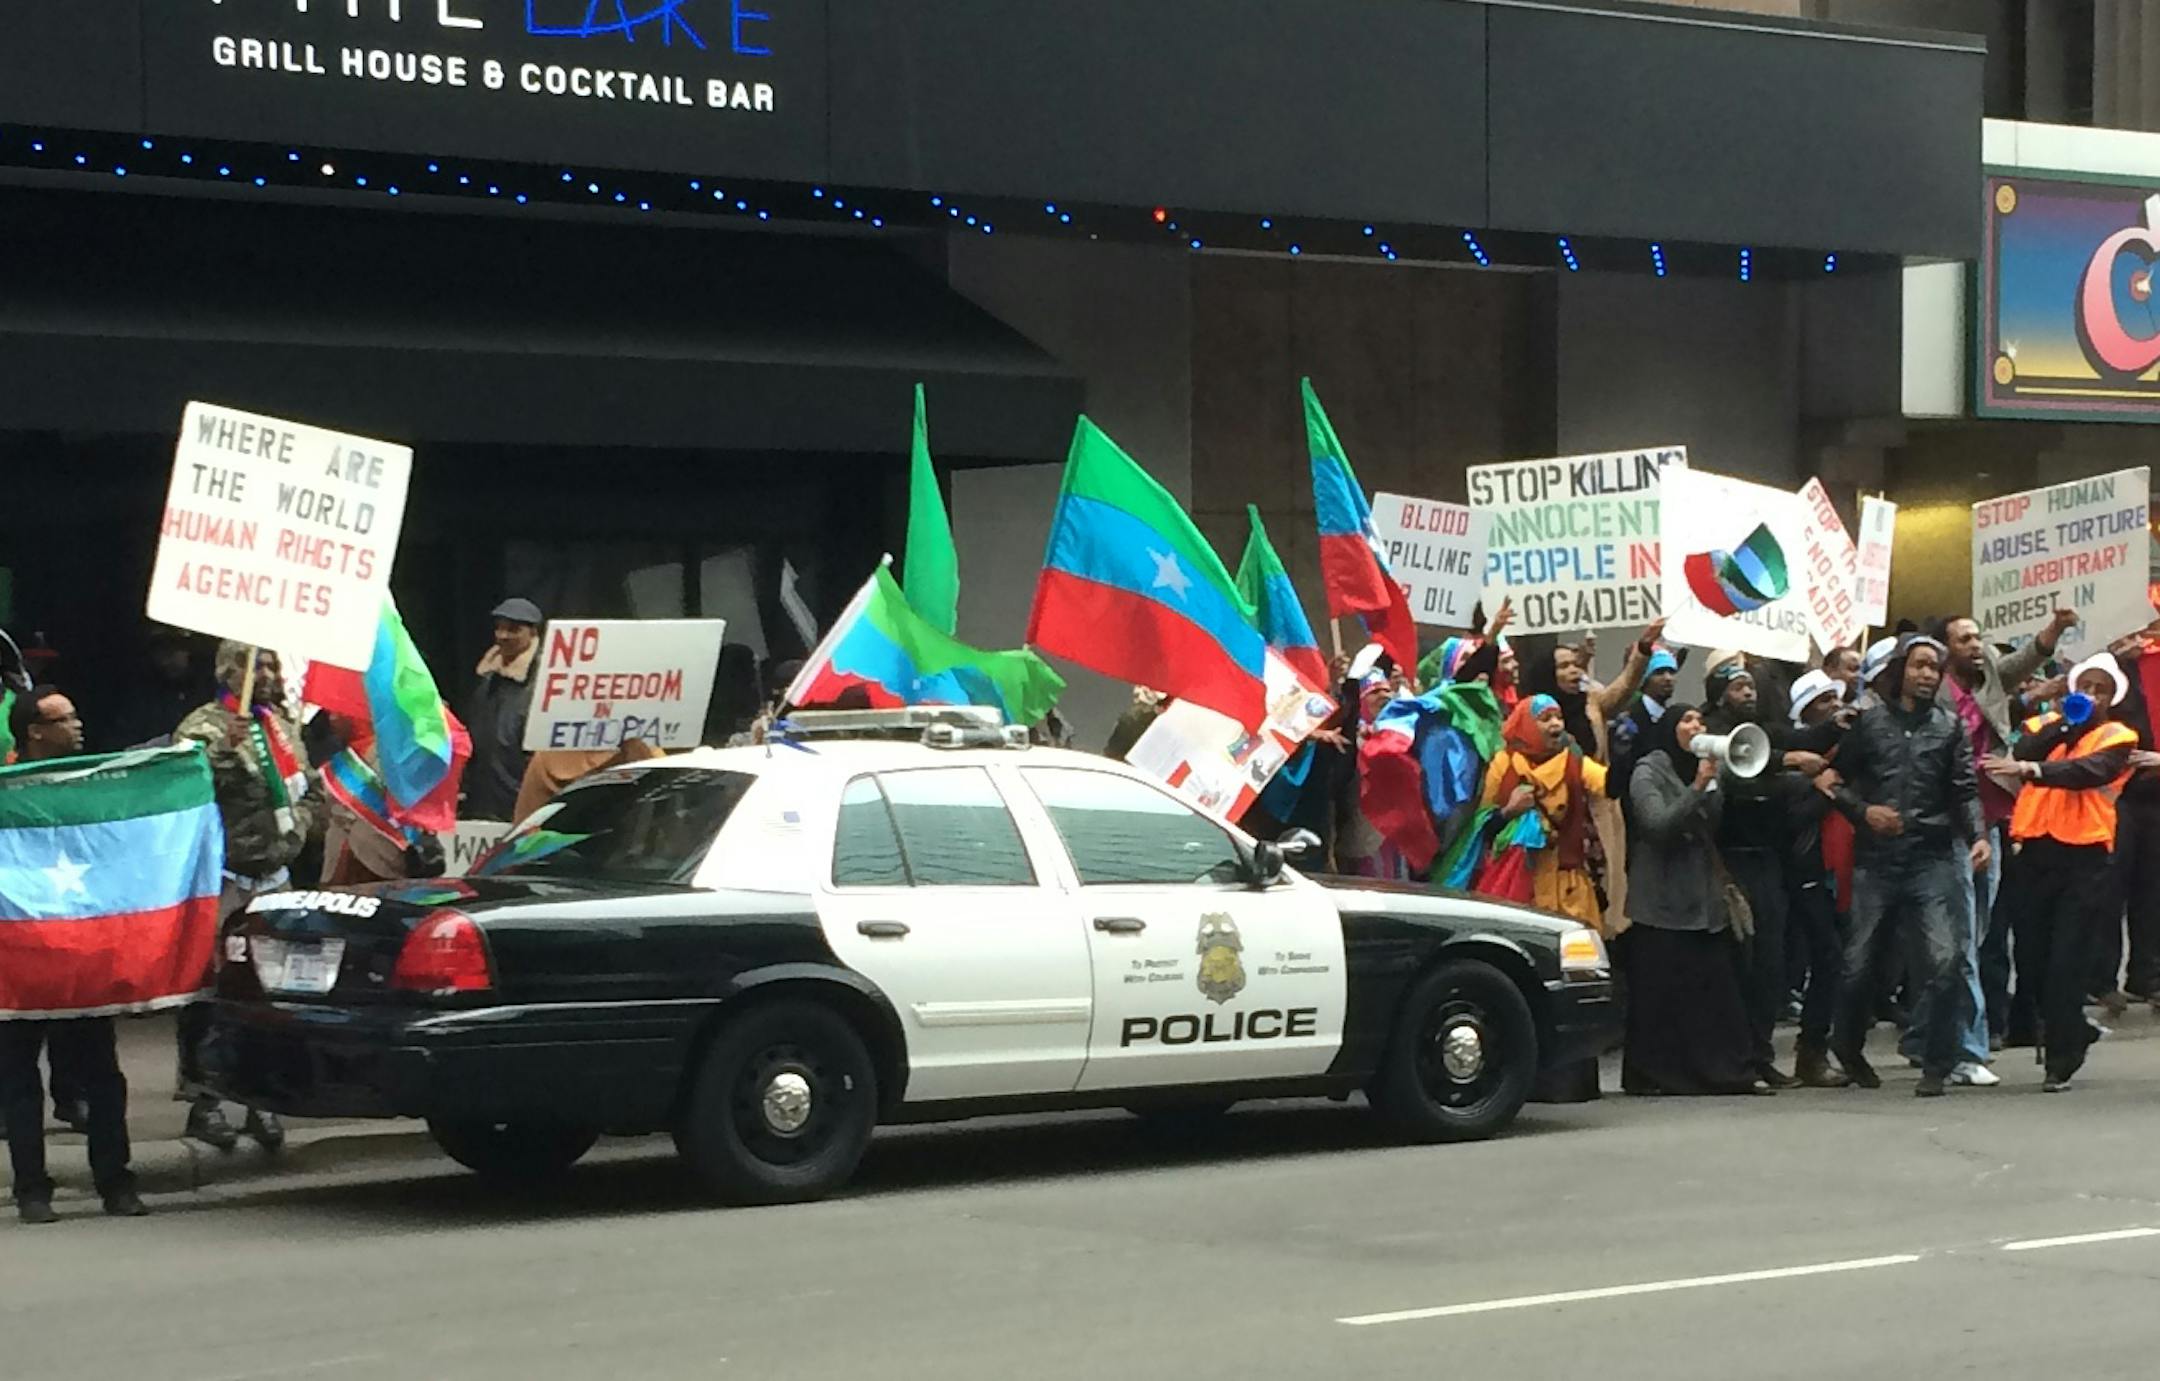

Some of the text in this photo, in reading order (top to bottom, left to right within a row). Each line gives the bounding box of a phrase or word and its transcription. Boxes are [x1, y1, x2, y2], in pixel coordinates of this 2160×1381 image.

[212, 35, 774, 112] GRILL HOUSE & COCKTAIL BAR
[197, 413, 385, 490] WHERE ARE
[192, 463, 376, 536] THE WORLD
[1471, 464, 1562, 506] STOP
[1977, 476, 2115, 530] STOP HUMAN
[162, 507, 260, 551] HUMAN
[1400, 503, 1470, 537] BLOOD
[1487, 499, 1661, 549] INNOCENT
[1807, 484, 1841, 533] STOP
[1384, 539, 1472, 577] PILLING
[1980, 505, 2147, 566] ABUSE TORTURE
[1482, 542, 1662, 588] PEOPLE IN
[176, 562, 333, 618] AGENCIES
[1424, 586, 1457, 616] OIL
[1523, 583, 1662, 628] OGADEN
[1982, 581, 2096, 633] ARREST IN
[1732, 606, 1807, 636] OLLARS
[547, 627, 600, 669] NO
[541, 668, 684, 713] FREEDOM
[593, 701, 614, 719] IN
[1120, 1006, 1318, 1047] POLICE
